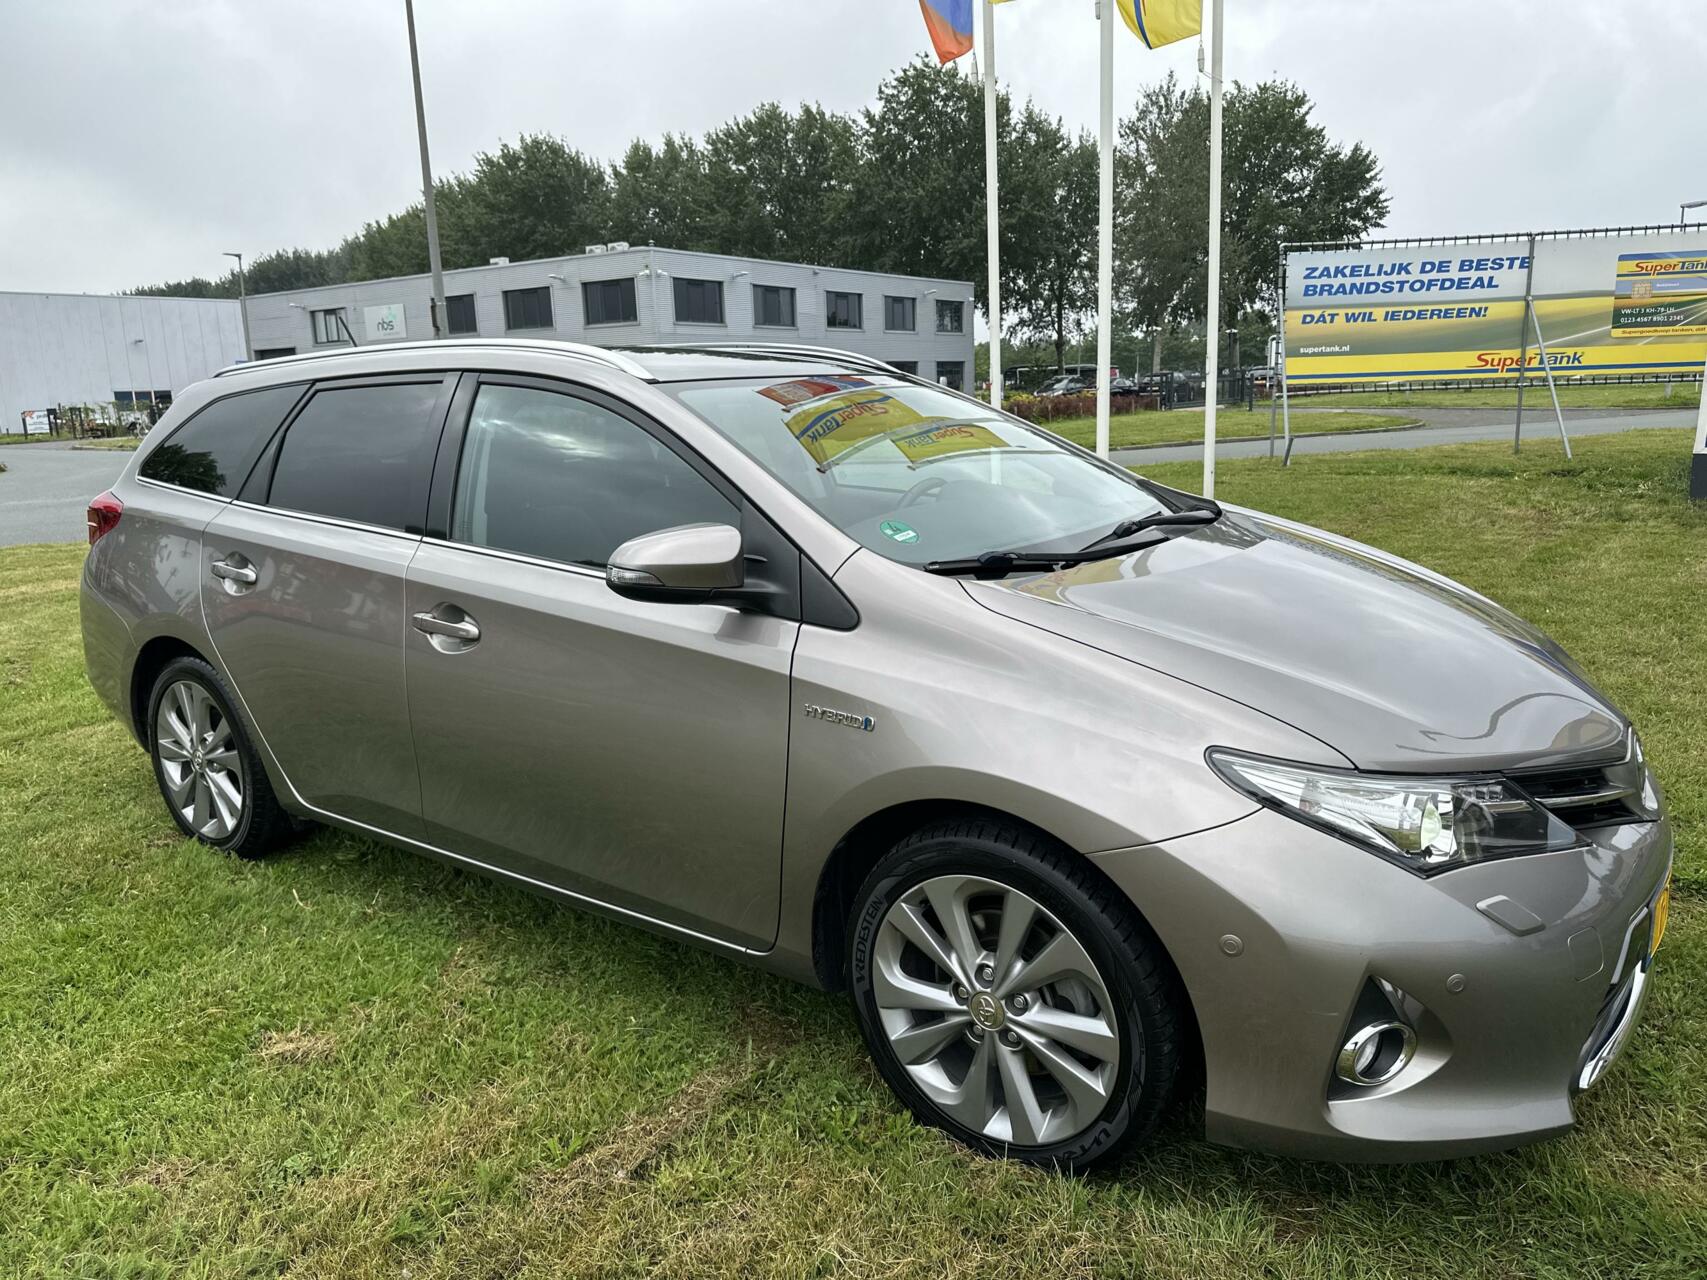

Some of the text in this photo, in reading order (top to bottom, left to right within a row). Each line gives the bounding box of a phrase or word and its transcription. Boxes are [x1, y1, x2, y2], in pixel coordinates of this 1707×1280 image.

[1302, 256, 1534, 280] ZAKELIJK DE BESTE
[1302, 275, 1499, 297] BRANDSTOFDEAL
[376, 317, 394, 332] nbs
[1301, 306, 1489, 325] DÁT WIL IEDEREEN!
[1300, 344, 1350, 355] supertank.nl
[803, 703, 863, 730] HYBRID
[855, 894, 884, 985] VREDESTEIN
